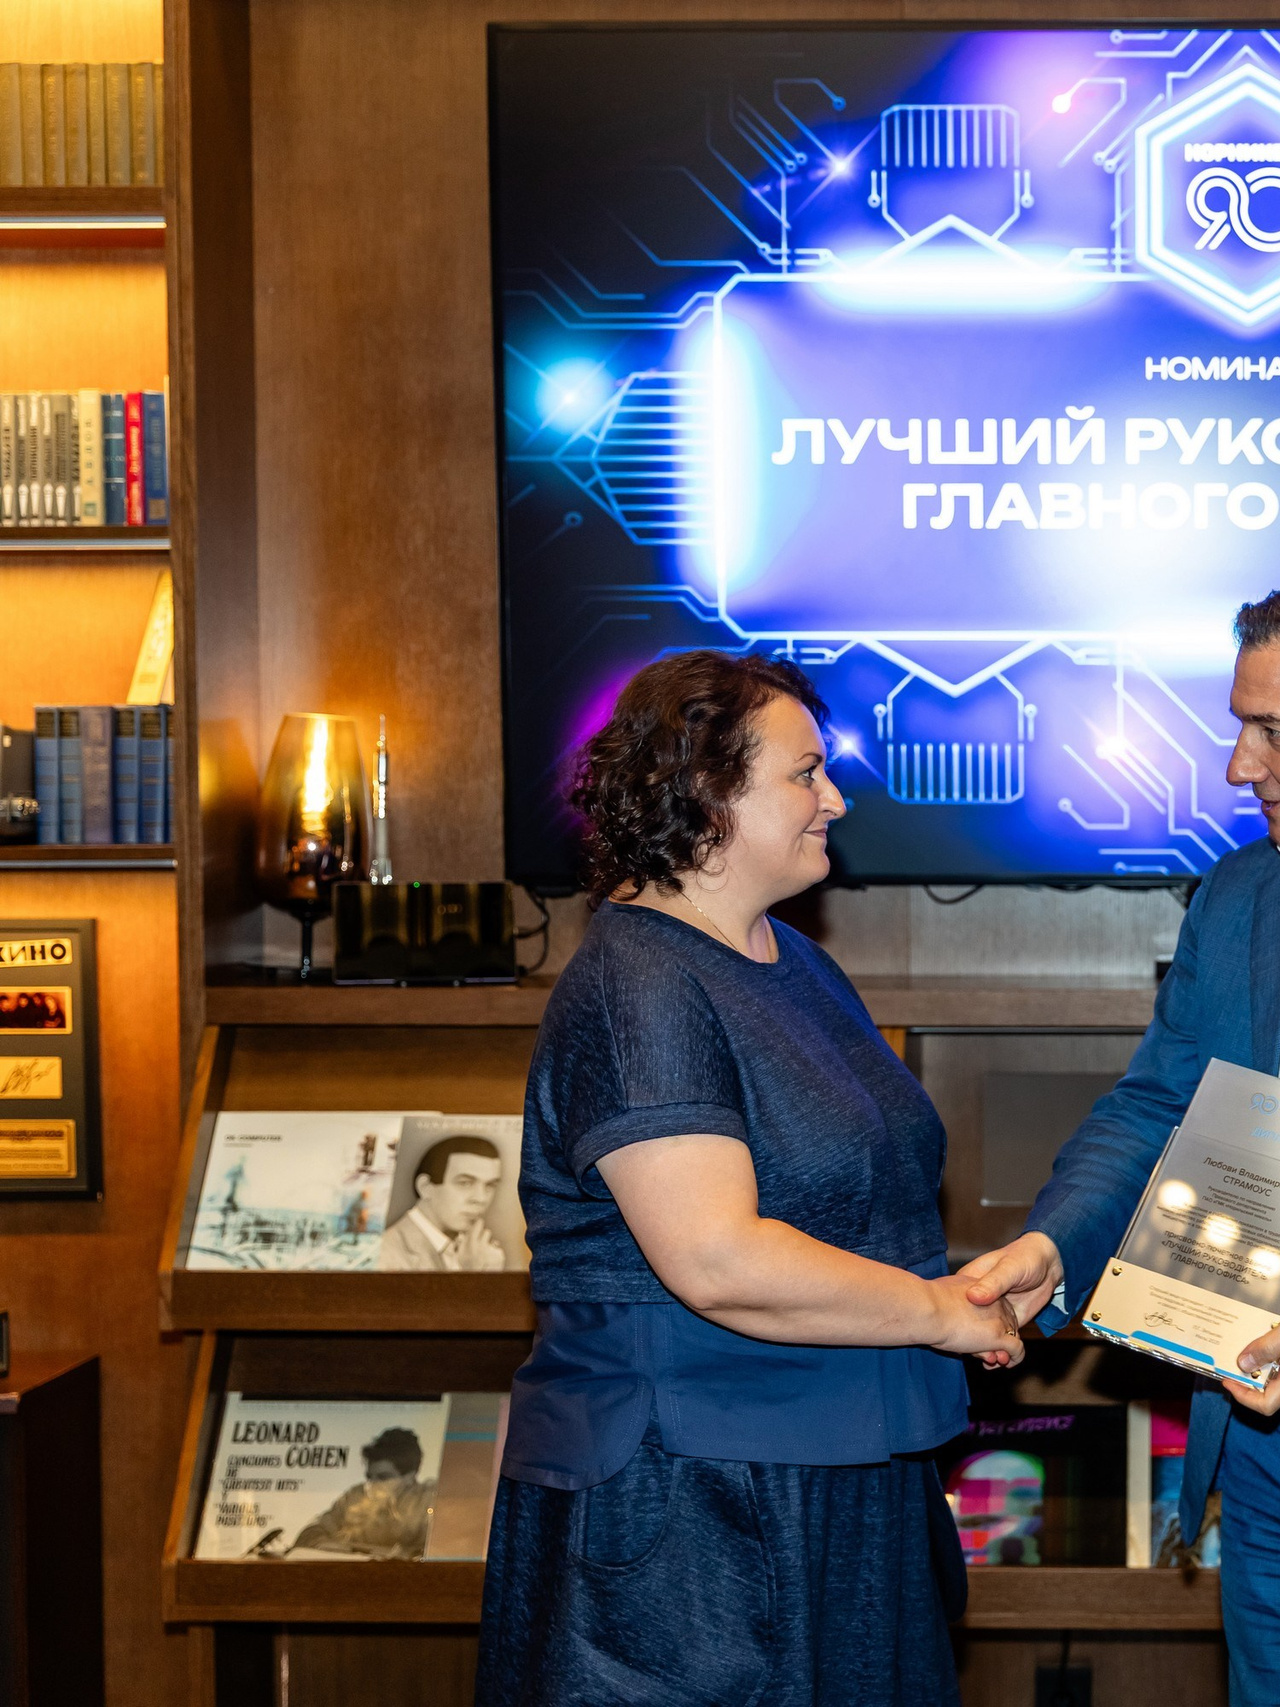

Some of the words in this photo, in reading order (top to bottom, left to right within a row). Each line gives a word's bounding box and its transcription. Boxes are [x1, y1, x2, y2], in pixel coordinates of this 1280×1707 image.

[772, 405, 1105, 466] ЛУЧШИЙ
[901, 484, 1280, 531] ГЛАВНОГО
[1203, 1156, 1237, 1176] Любови
[1223, 1175, 1272, 1198] СТРАМОУС
[1169, 1252, 1215, 1273] ГЛАВНОГО
[1215, 1267, 1251, 1285] ОФИСА»
[230, 1420, 320, 1444] LEONARD
[285, 1445, 350, 1469] COHEN
